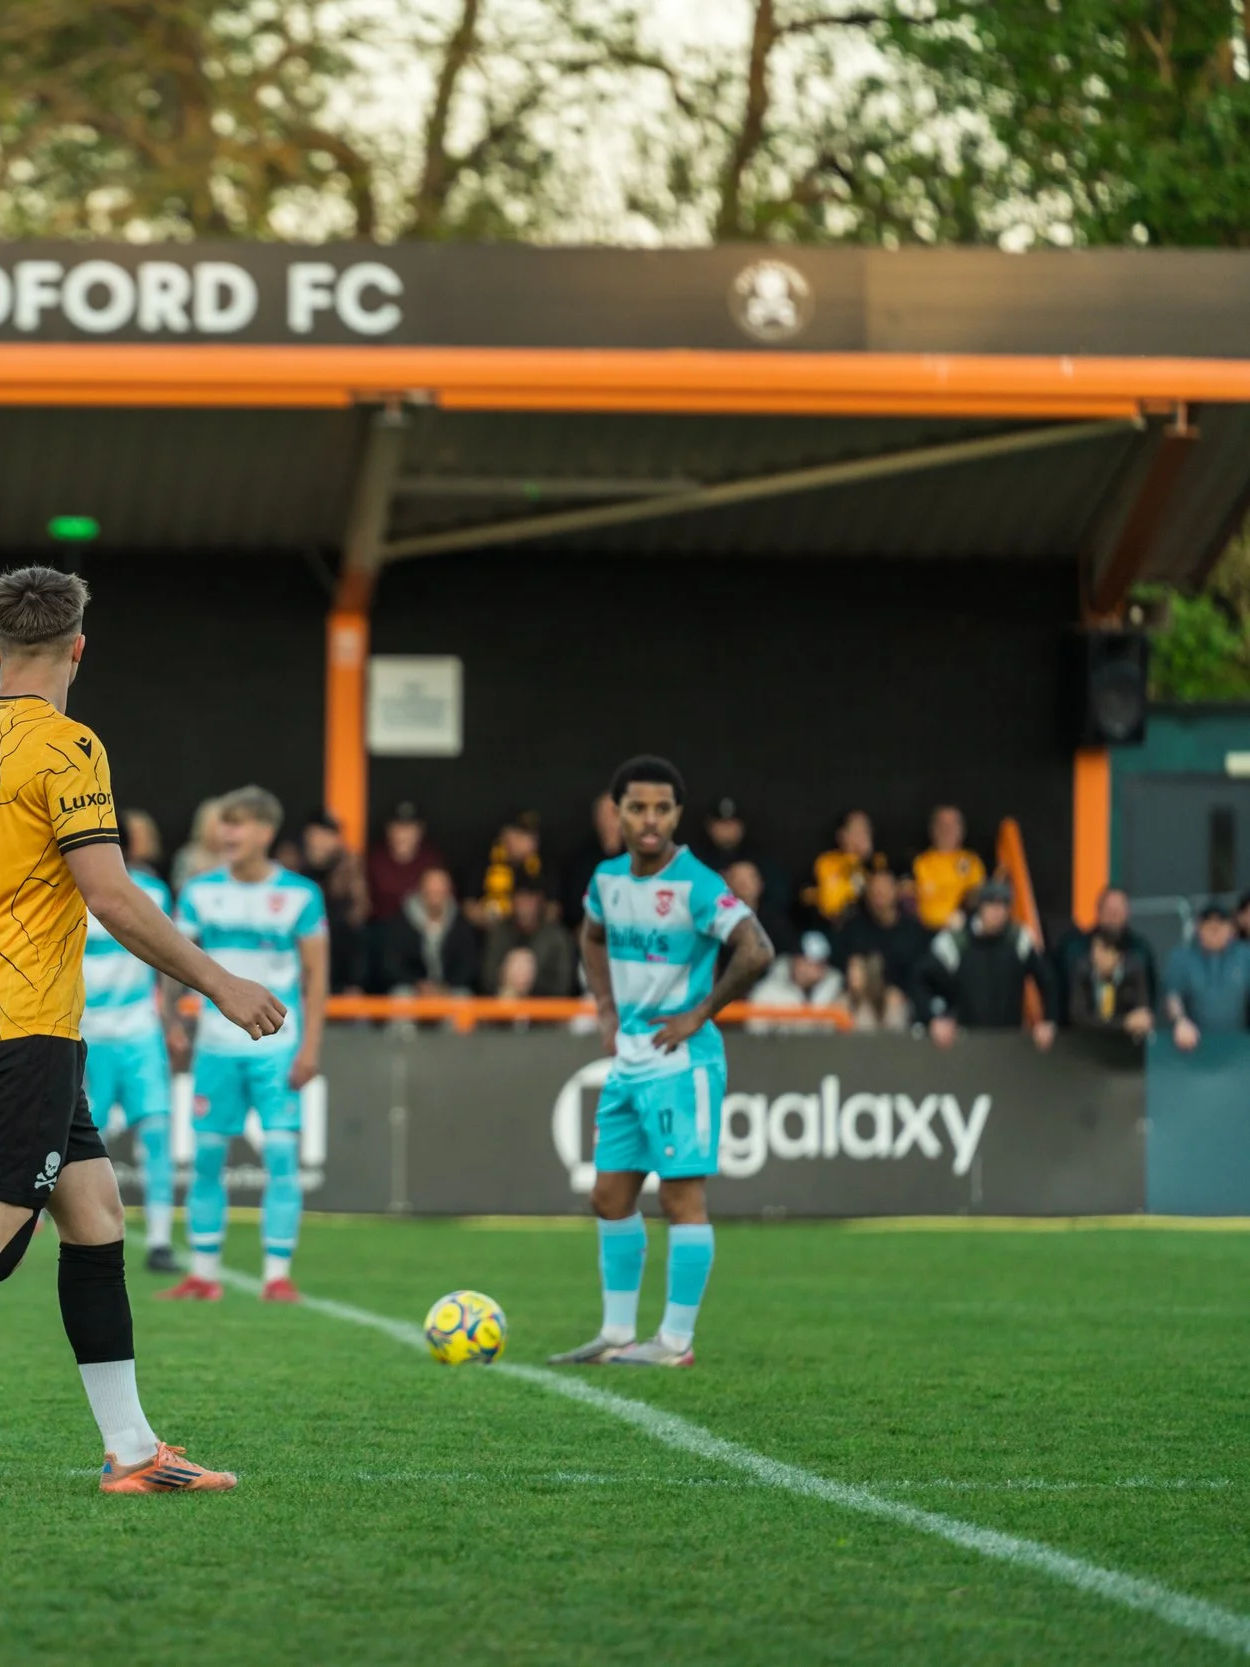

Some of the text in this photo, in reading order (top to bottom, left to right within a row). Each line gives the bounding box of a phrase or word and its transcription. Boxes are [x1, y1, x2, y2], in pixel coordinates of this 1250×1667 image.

[286, 261, 405, 335] FC
[59, 792, 111, 813] Luxor
[718, 1074, 992, 1177] galaxy
